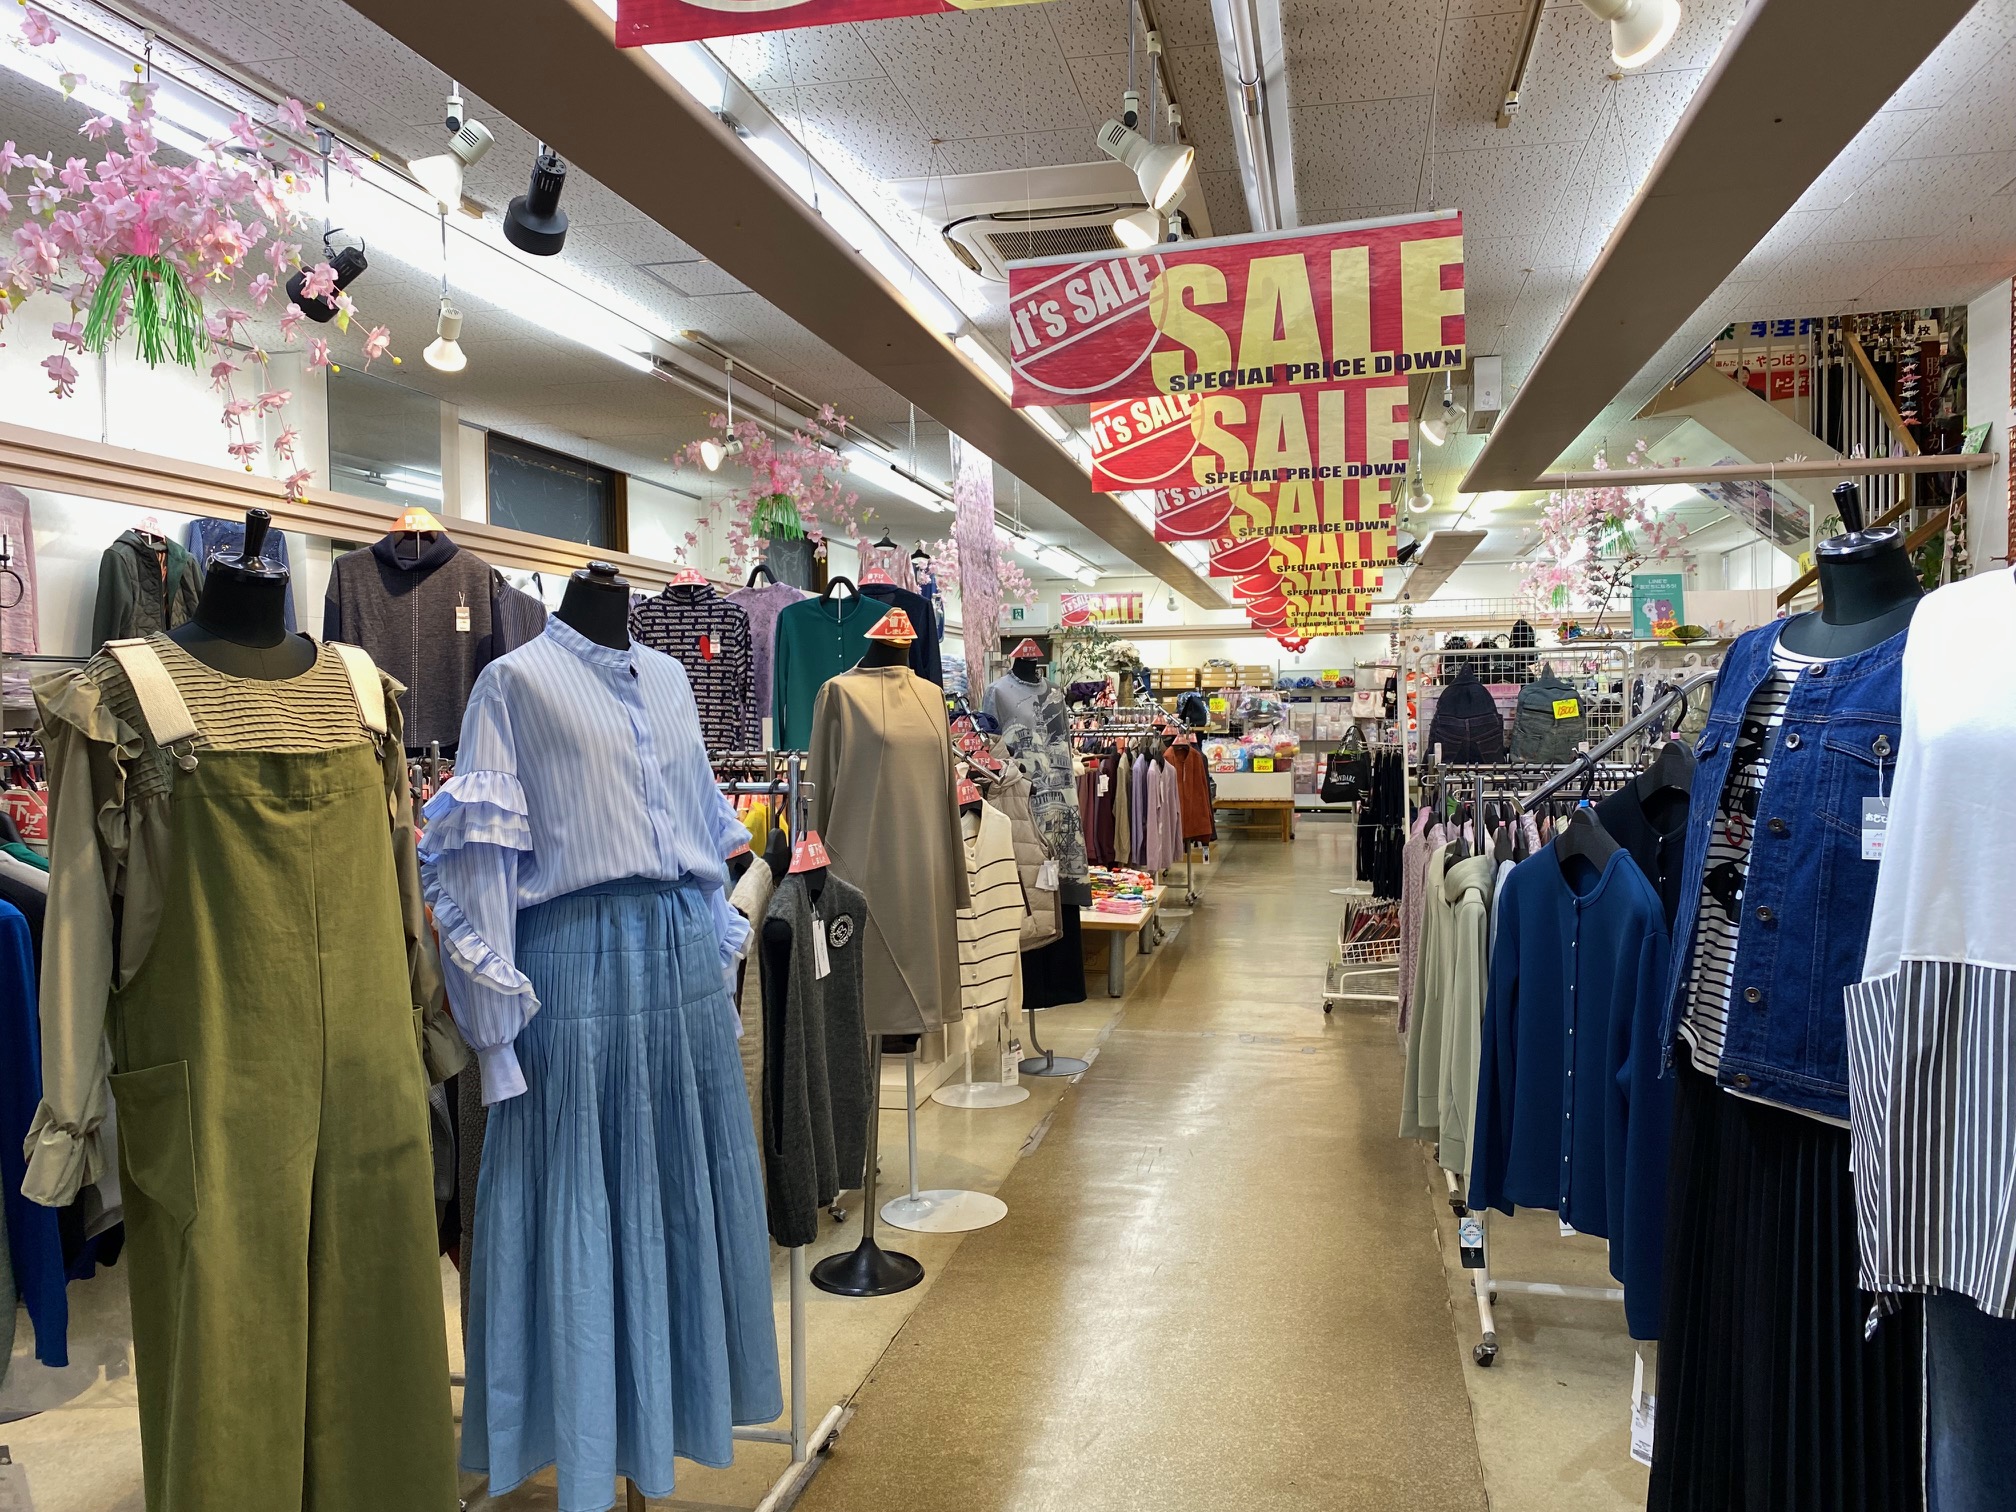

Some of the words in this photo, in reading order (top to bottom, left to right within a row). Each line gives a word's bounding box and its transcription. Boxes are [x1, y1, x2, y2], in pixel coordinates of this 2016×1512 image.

[1065, 257, 1156, 324] SALE
[1149, 236, 1466, 394] SALE
[1918, 325, 1931, 337] 校
[1170, 366, 1276, 392] SPECIAL
[1286, 358, 1365, 381] PRICE
[1375, 349, 1462, 373] DOWN
[1130, 393, 1197, 434] SALE
[1191, 386, 1409, 487] SALE
[1205, 469, 1279, 485] SPECIAL
[1287, 465, 1341, 480] PRICE
[1347, 462, 1406, 477] DOWN
[1229, 478, 1391, 537] SALE
[1239, 525, 1296, 537] SPECIAL
[1301, 523, 1340, 534] PRICE
[1345, 520, 1389, 531] DOWN
[1269, 522, 1397, 573] SALE
[1277, 563, 1320, 573] SPECIAL
[1326, 561, 1357, 570] PRICE
[1361, 559, 1396, 568] DOWN
[1088, 596, 1143, 623] SALE
[1287, 588, 1322, 596] SPECIAL
[1325, 587, 1351, 595] PRICE
[1354, 586, 1382, 594] DOWN
